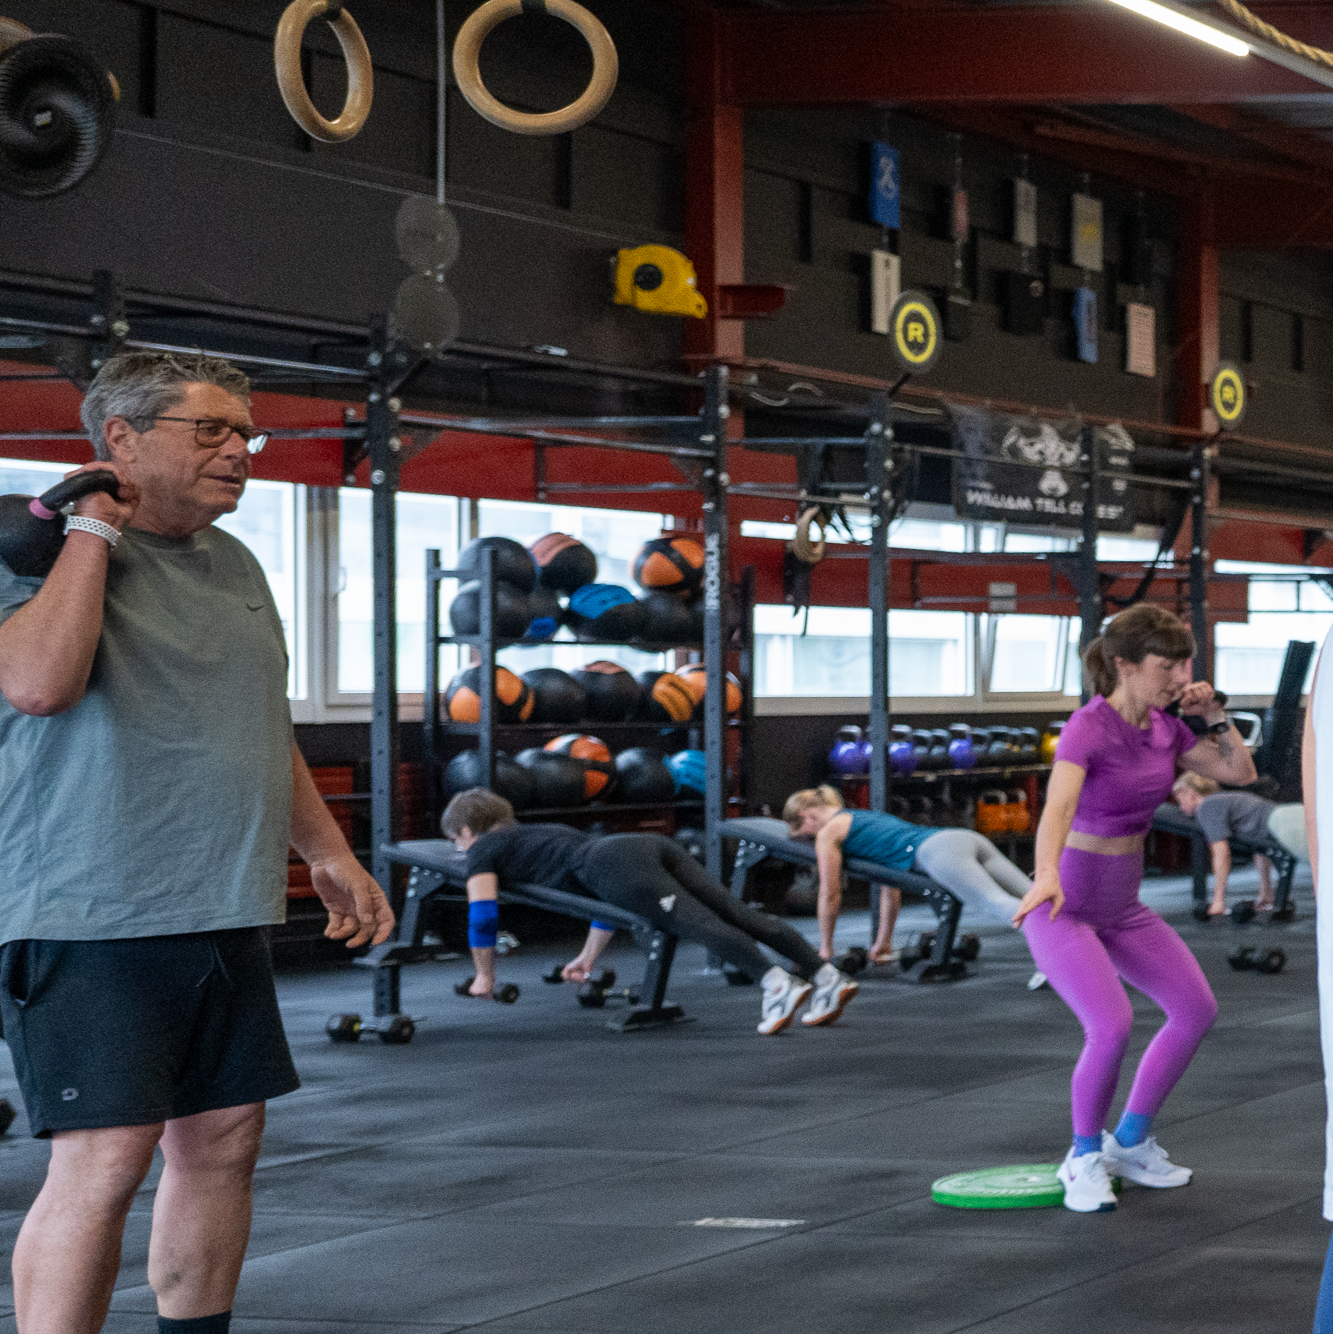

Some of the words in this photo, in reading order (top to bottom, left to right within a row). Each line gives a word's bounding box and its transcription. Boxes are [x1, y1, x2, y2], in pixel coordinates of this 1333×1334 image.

[907, 321, 925, 343] R
[965, 490, 1034, 511] WILLIAM
[1034, 497, 1067, 514] TELL
[1068, 501, 1125, 519] COEST
